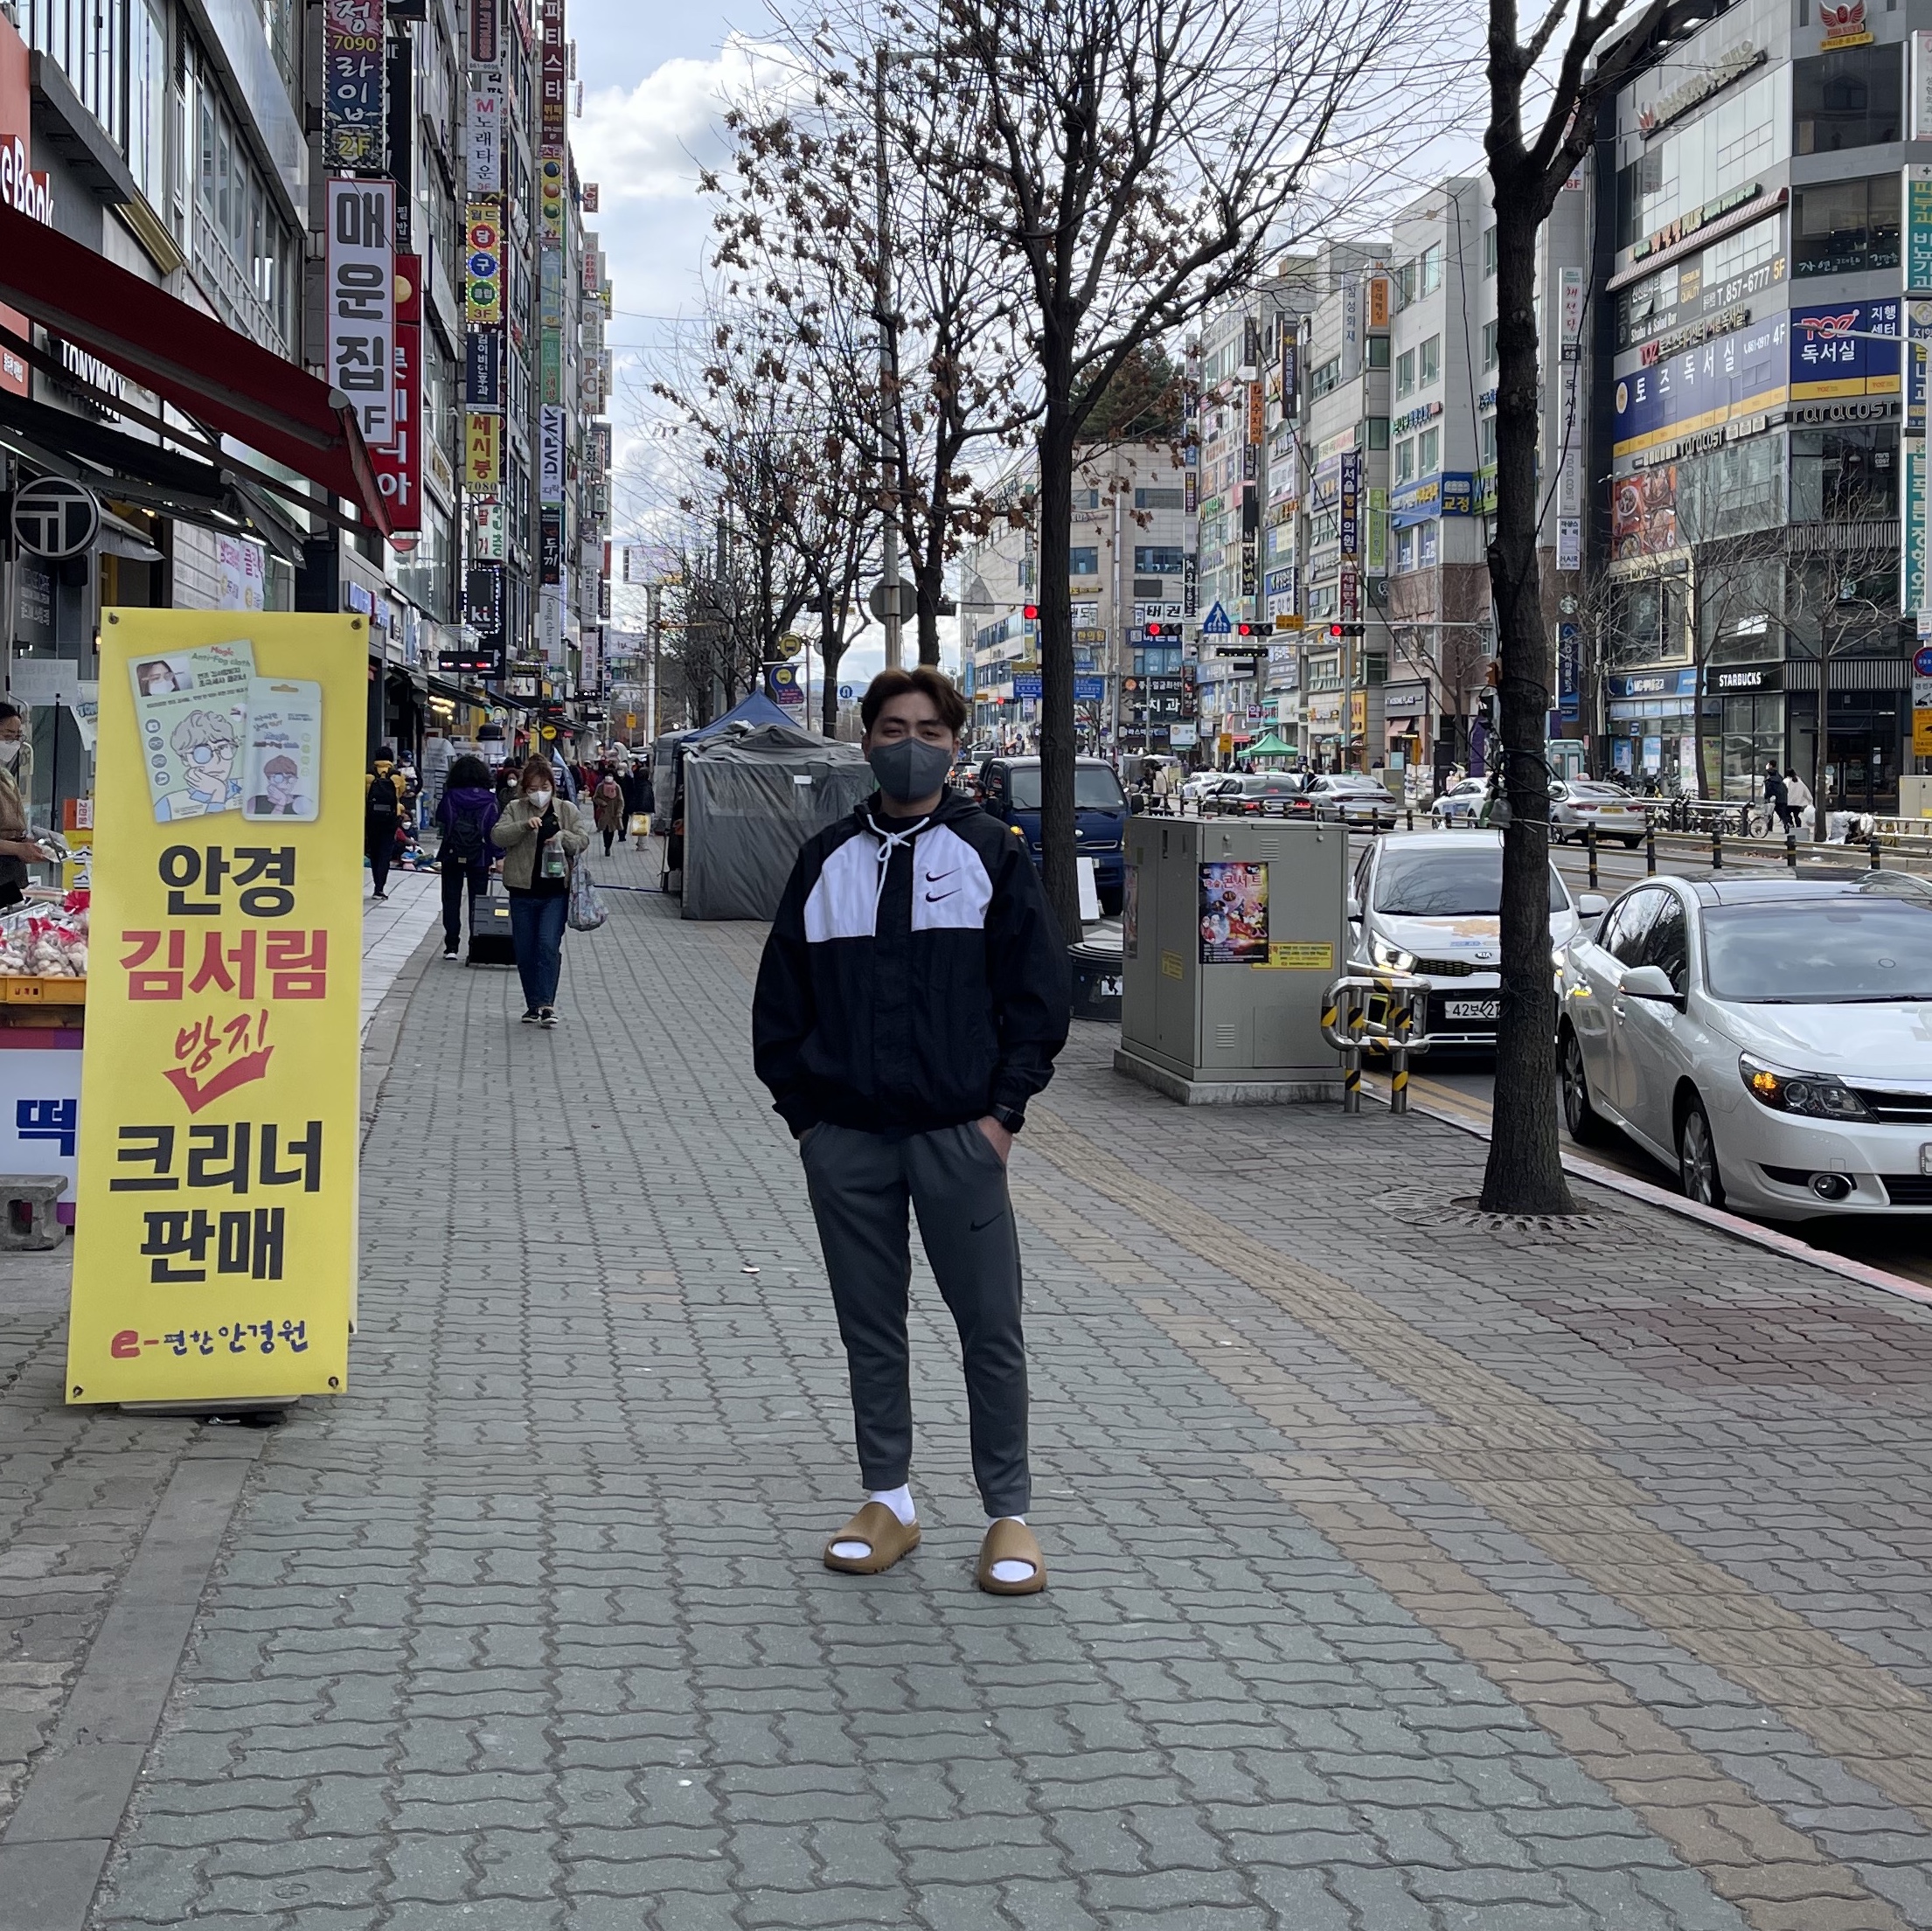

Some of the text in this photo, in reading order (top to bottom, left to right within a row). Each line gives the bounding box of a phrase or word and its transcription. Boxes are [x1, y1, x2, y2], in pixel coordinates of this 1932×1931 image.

[332, 35, 378, 52] 7090
[335, 56, 374, 129] 라이브
[338, 135, 372, 157] 2F
[475, 116, 495, 180] 노래타운
[1773, 257, 1787, 280] 5F
[337, 191, 386, 392] 매운집
[473, 309, 492, 319] 3F
[1872, 305, 1897, 322] 지행
[1773, 323, 1786, 346] 4F
[1802, 340, 1855, 365] 독서실
[1635, 337, 1735, 403] 토즈 독서실
[1564, 379, 1578, 427] 독서실
[472, 416, 492, 479] 세시봉
[467, 482, 497, 491] 7080
[1442, 496, 1470, 513] 교정
[1719, 671, 1762, 688] STARBUCKS
[1149, 697, 1181, 712] 치과
[158, 844, 295, 918] 안경
[1224, 874, 1263, 889] 콘서트
[120, 929, 327, 1001] 김서림
[16, 1098, 77, 1157] 떡
[109, 1120, 323, 1193] 크리너
[140, 1207, 285, 1284] 판매
